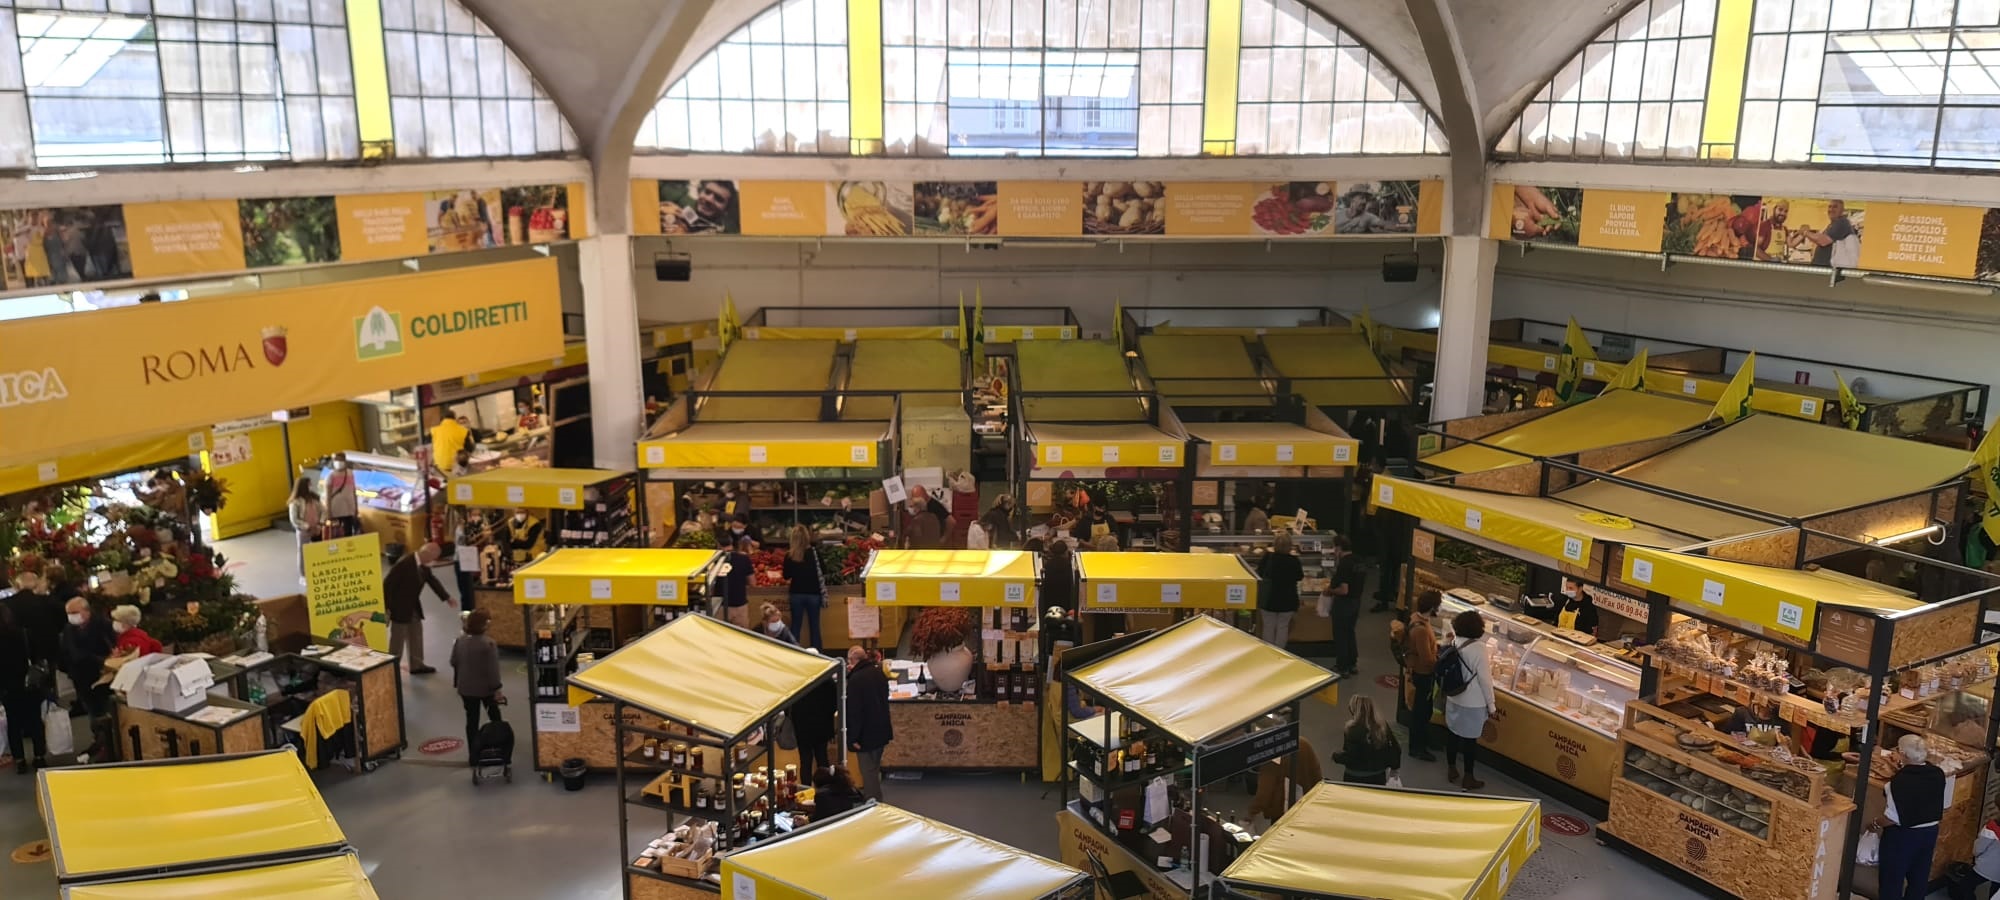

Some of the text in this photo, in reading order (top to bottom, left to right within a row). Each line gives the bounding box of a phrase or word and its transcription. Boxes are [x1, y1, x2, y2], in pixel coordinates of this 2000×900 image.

[1893, 224, 1948, 235] ORGOGLIO E
[1900, 243, 1924, 252] SIETE
[1888, 252, 1917, 262] BUONE
[410, 300, 528, 339] COLDIRETTI
[142, 342, 255, 385] ROMA
[0, 367, 68, 407] ICA
[312, 566, 348, 578] LASCIA
[313, 569, 374, 585] UN'OFFERTA
[315, 585, 371, 601] DONAZIONE
[324, 583, 340, 592] FAI
[343, 579, 363, 588] UNA
[325, 599, 342, 607] CHI
[336, 598, 379, 612] BISOGNO
[1548, 730, 1587, 752] CAMPAGNA
[1555, 741, 1579, 757] AMICA
[1679, 812, 1720, 837] CAMPAGNA
[1684, 824, 1712, 841] AMICA
[1074, 828, 1109, 855] CAMPAGNA
[1811, 819, 1830, 898] PANE
